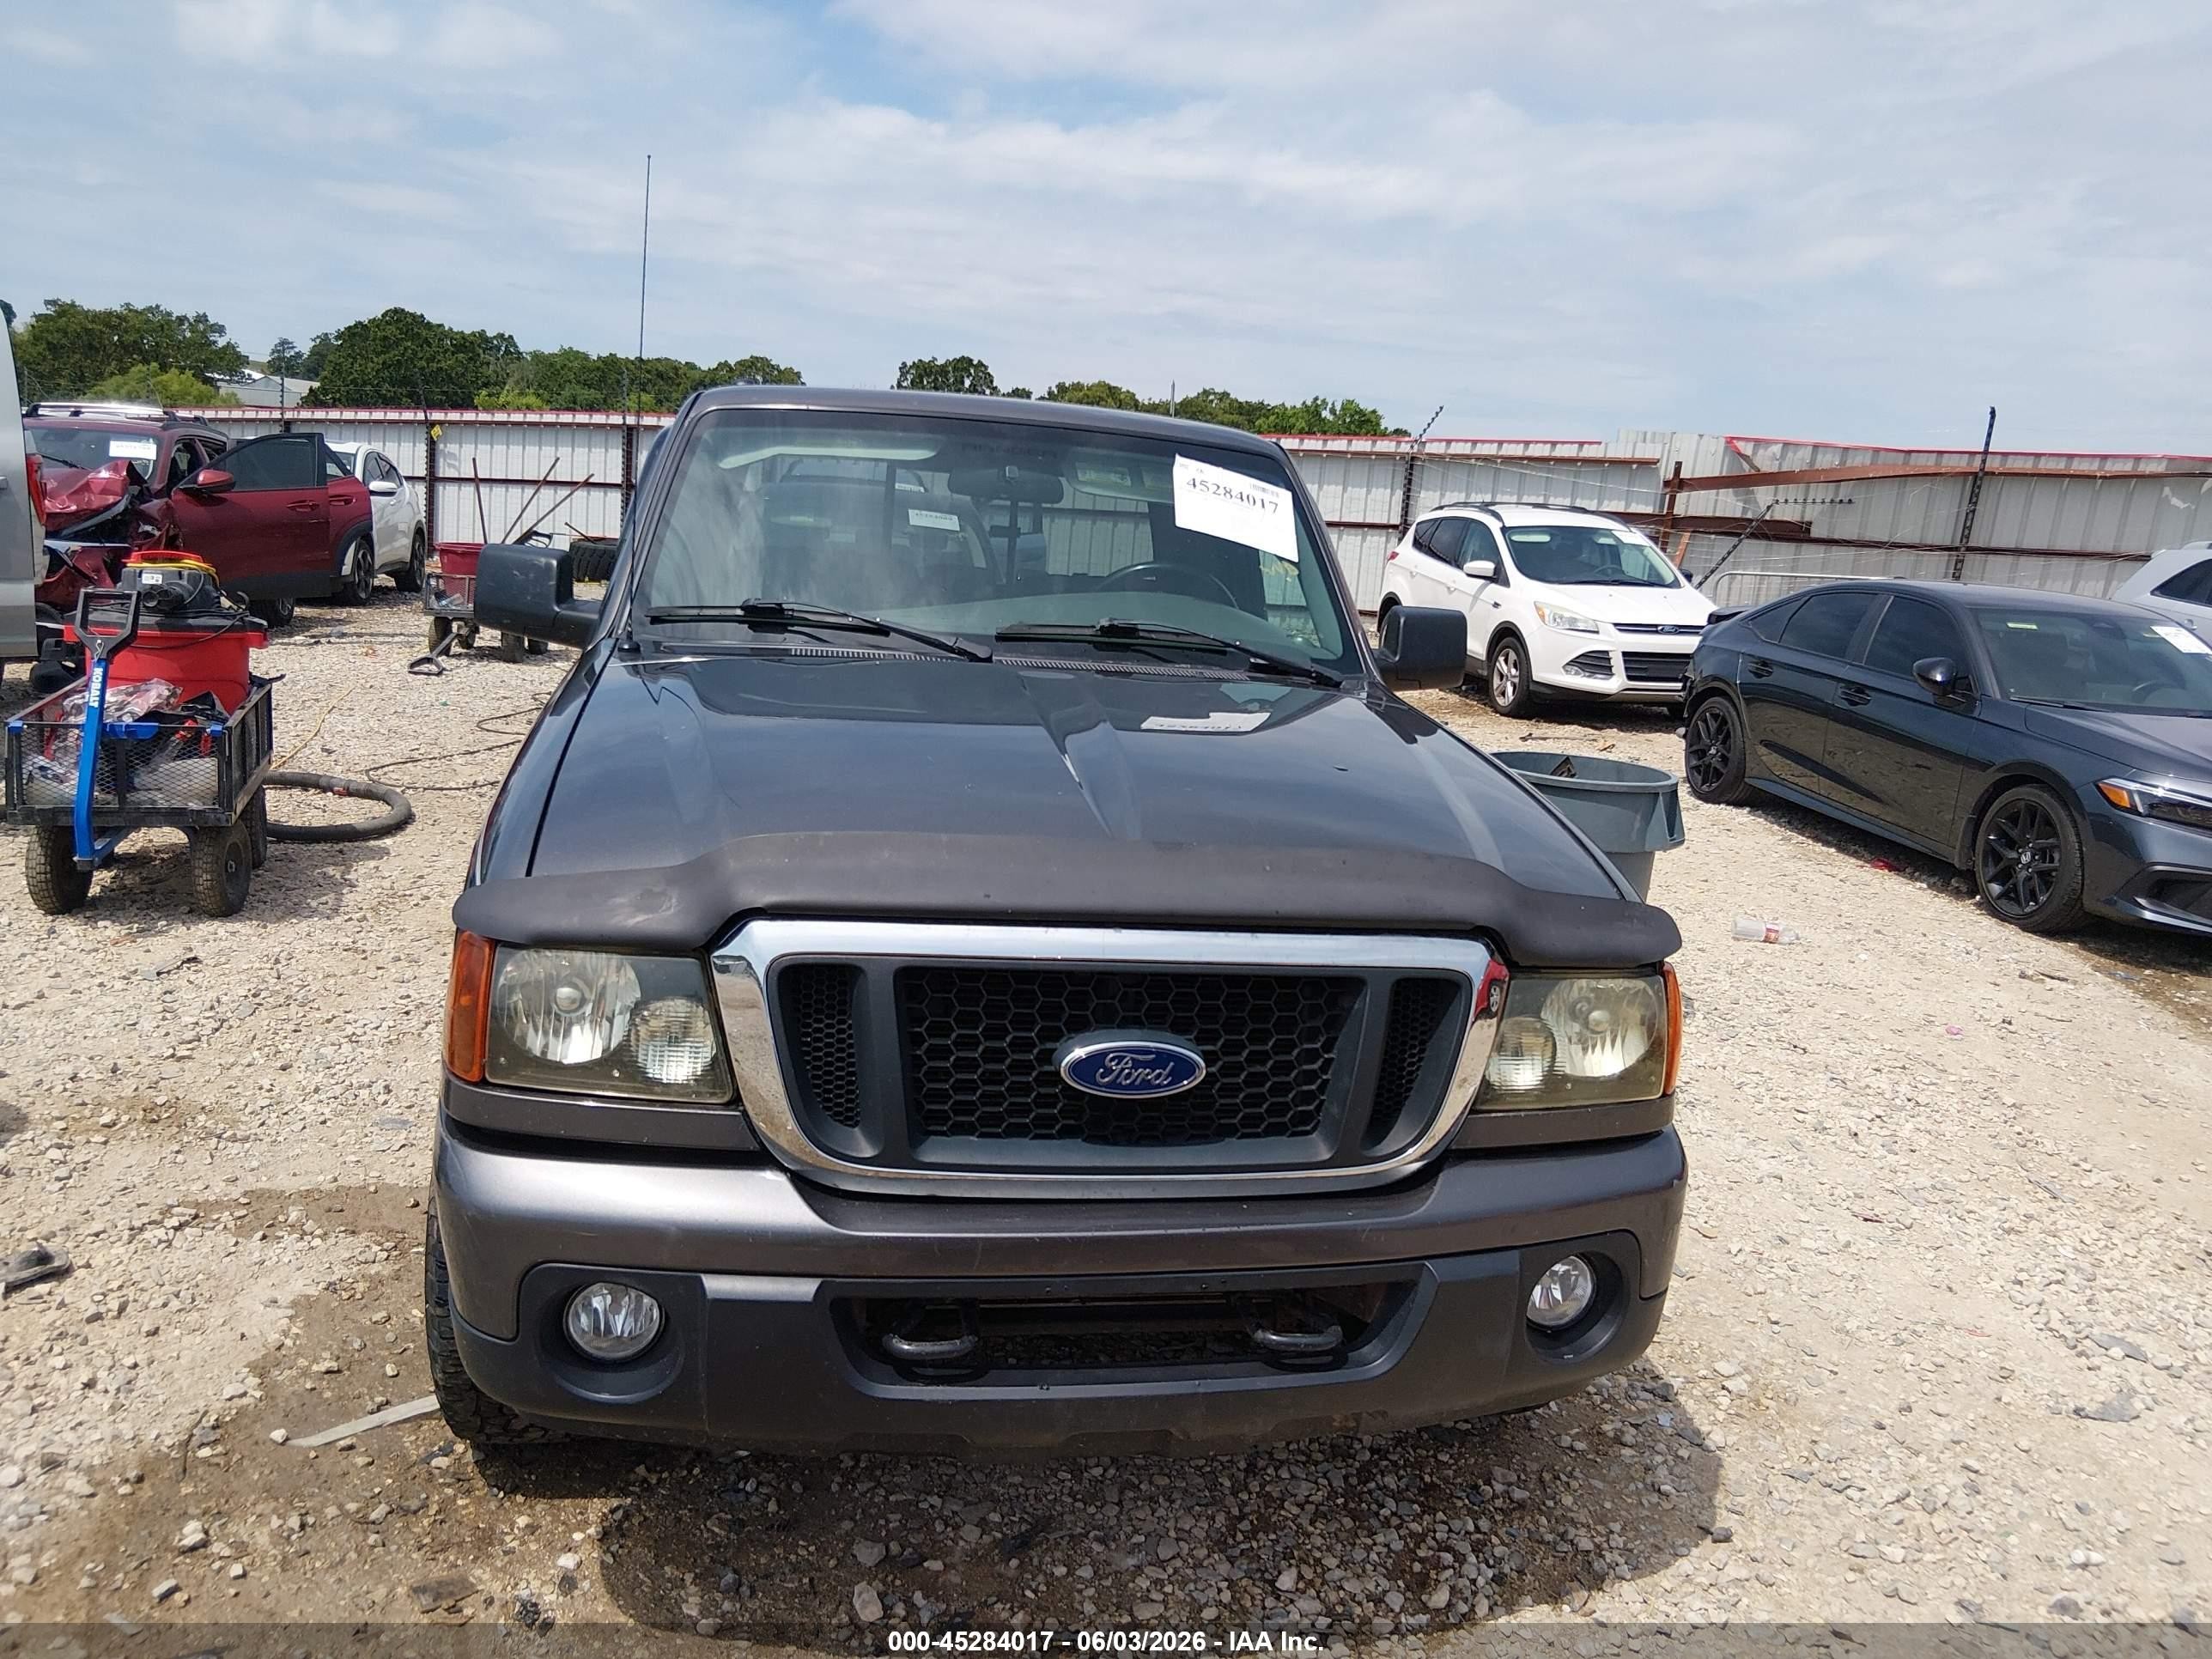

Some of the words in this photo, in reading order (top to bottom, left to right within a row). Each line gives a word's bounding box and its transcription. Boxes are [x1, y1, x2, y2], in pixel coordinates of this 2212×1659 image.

[1187, 477, 1279, 514] 45284017
[88, 667, 104, 708] KOBALT
[1095, 1052, 1175, 1086] Ford
